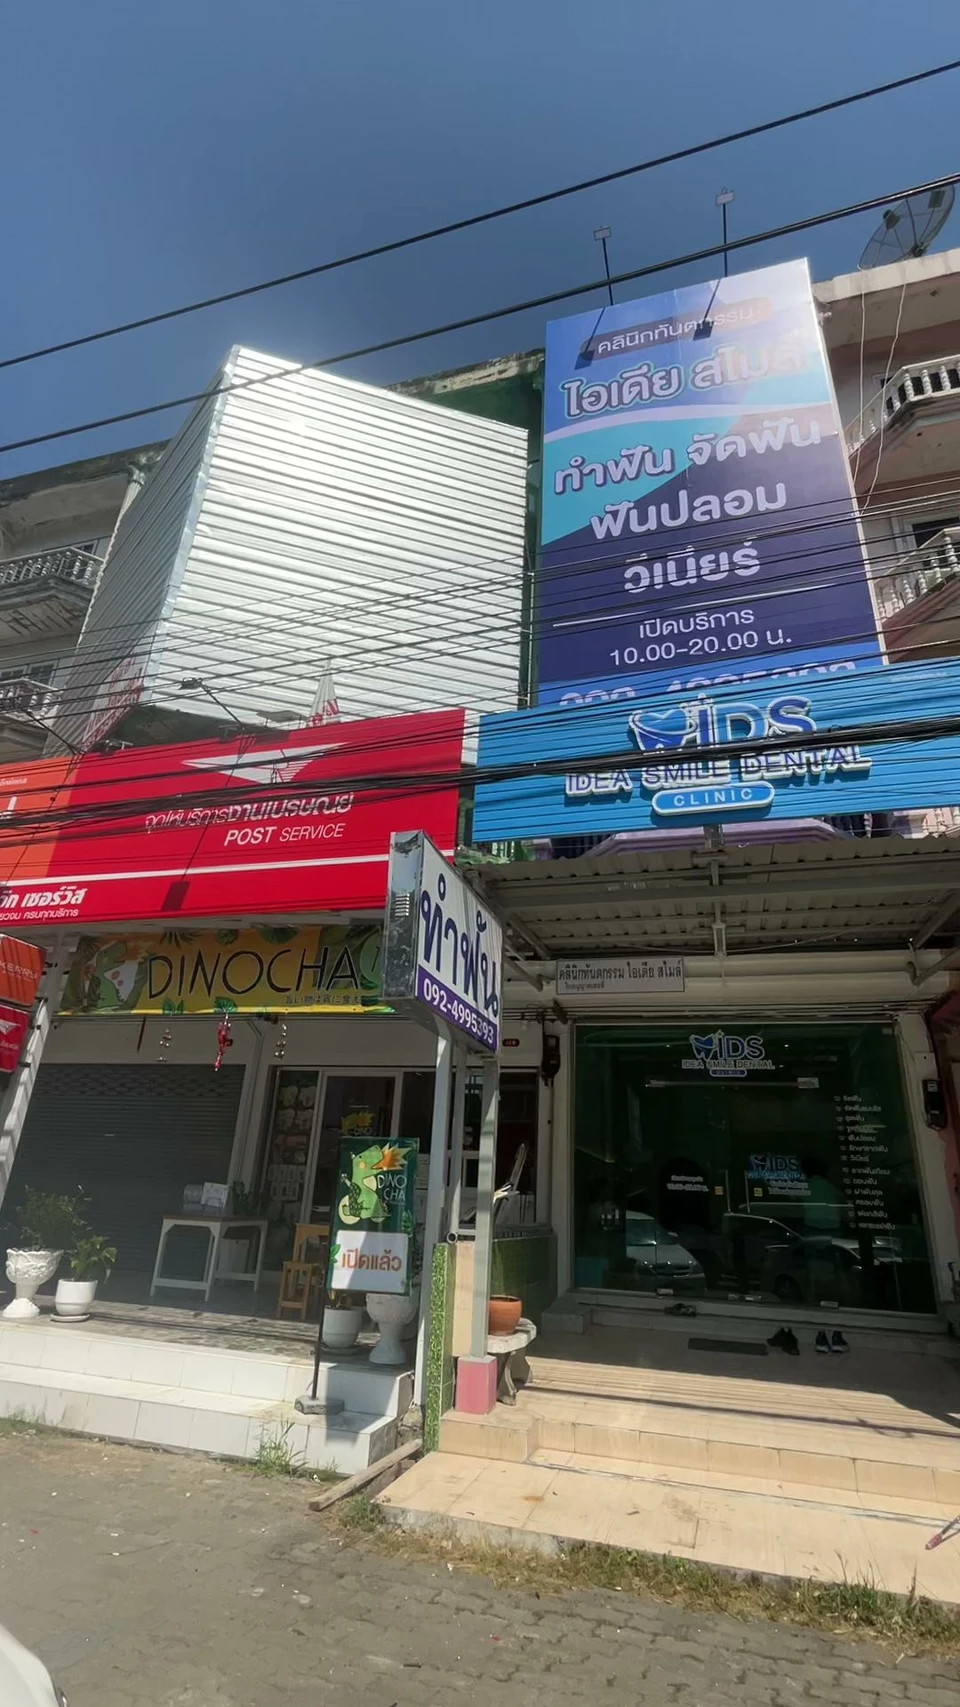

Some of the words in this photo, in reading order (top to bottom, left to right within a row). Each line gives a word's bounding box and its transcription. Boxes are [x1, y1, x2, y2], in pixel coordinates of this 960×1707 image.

[597, 309, 754, 354] คลินิกทันตกรรม
[562, 361, 681, 418] ไอเดีย
[555, 444, 676, 494] ทำฟัน
[686, 416, 821, 465] จัดฟัน
[590, 482, 787, 539] ฟันปลอม
[639, 609, 754, 639] เปิดบริการ
[610, 631, 758, 666] 10.00-20.00
[767, 629, 792, 644] น.
[566, 769, 632, 795] IDEA
[643, 759, 732, 791] SMILE
[739, 746, 871, 780] DENTAL
[674, 788, 753, 807] CLINIC
[224, 827, 276, 846] POST
[280, 823, 346, 842] SERVICE
[21, 886, 88, 907] เซอร์วิส
[24, 908, 79, 921] ครบทุกบริการ
[421, 873, 498, 1018] ทำฟัน
[149, 946, 360, 998] DINOCHA
[559, 964, 624, 980] คลินิกทันตกรรม
[627, 961, 654, 978] ไอเดีย
[657, 959, 682, 978] สไมล์
[423, 979, 494, 1045] 092-4995393
[681, 1059, 704, 1069] IDEA
[706, 1059, 734, 1069] SMILE
[735, 1059, 776, 1070] DENTAL
[377, 1174, 407, 1189] DINO
[384, 1187, 406, 1201] CHA
[342, 1249, 402, 1272] เปิดแล้ว
